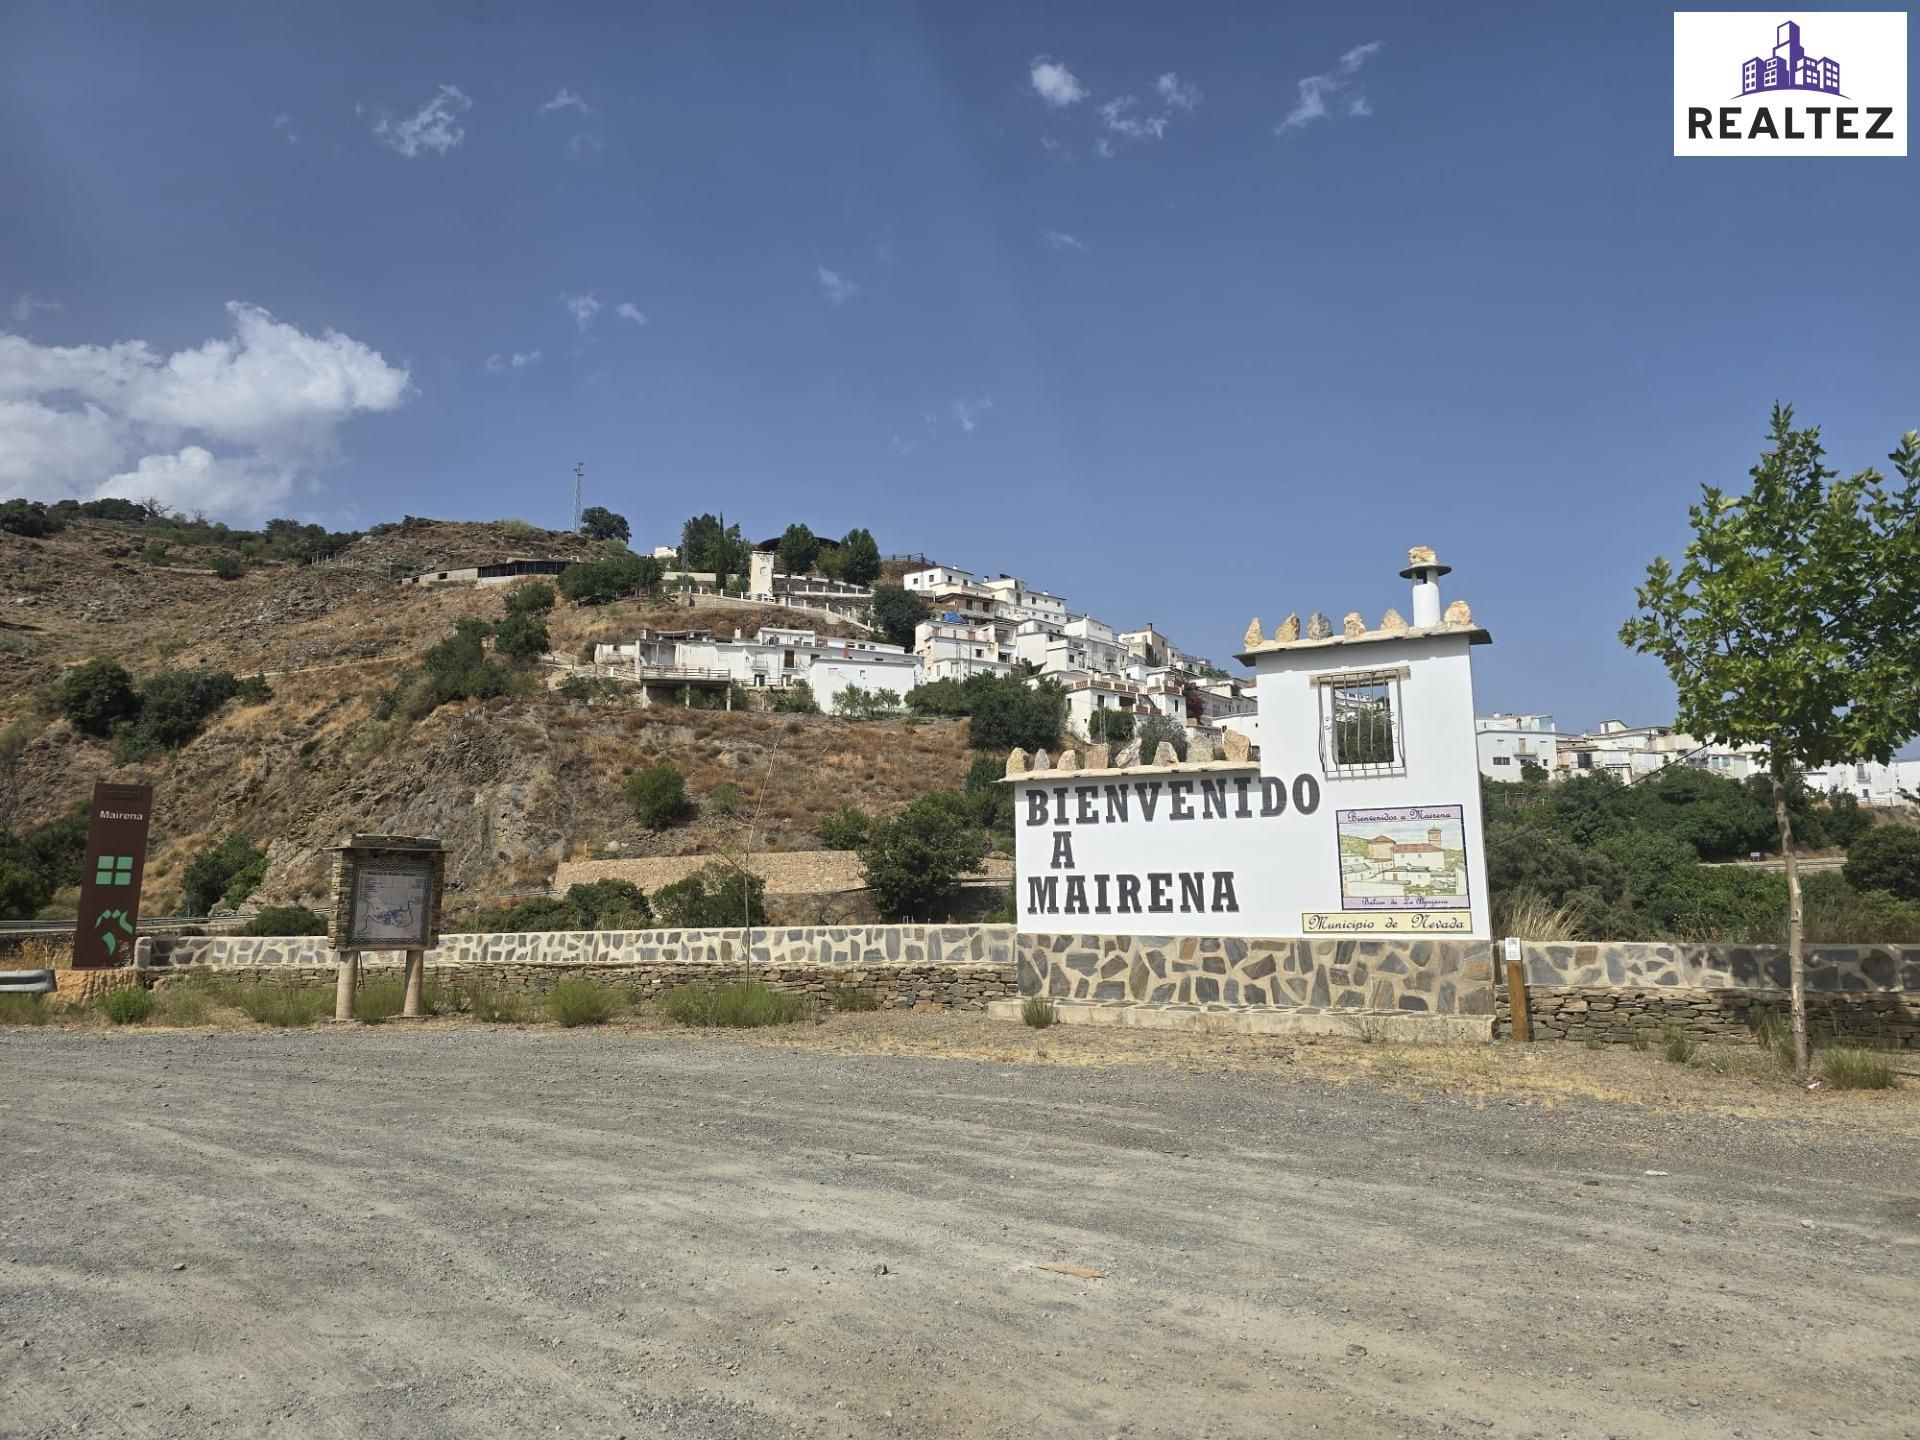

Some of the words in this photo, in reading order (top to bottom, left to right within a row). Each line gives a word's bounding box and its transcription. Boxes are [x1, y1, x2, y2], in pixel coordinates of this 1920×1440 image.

[1026, 774, 1320, 826] BIENVENIDO
[100, 810, 143, 820] Mairena
[1347, 811, 1397, 822] Bienvenidos
[1410, 808, 1451, 820] Mairena
[1051, 831, 1075, 869] A
[1027, 871, 1239, 914] MAIRENA
[1308, 913, 1375, 931] Municipio
[1385, 917, 1398, 929] de
[1411, 913, 1465, 929] Nevada
